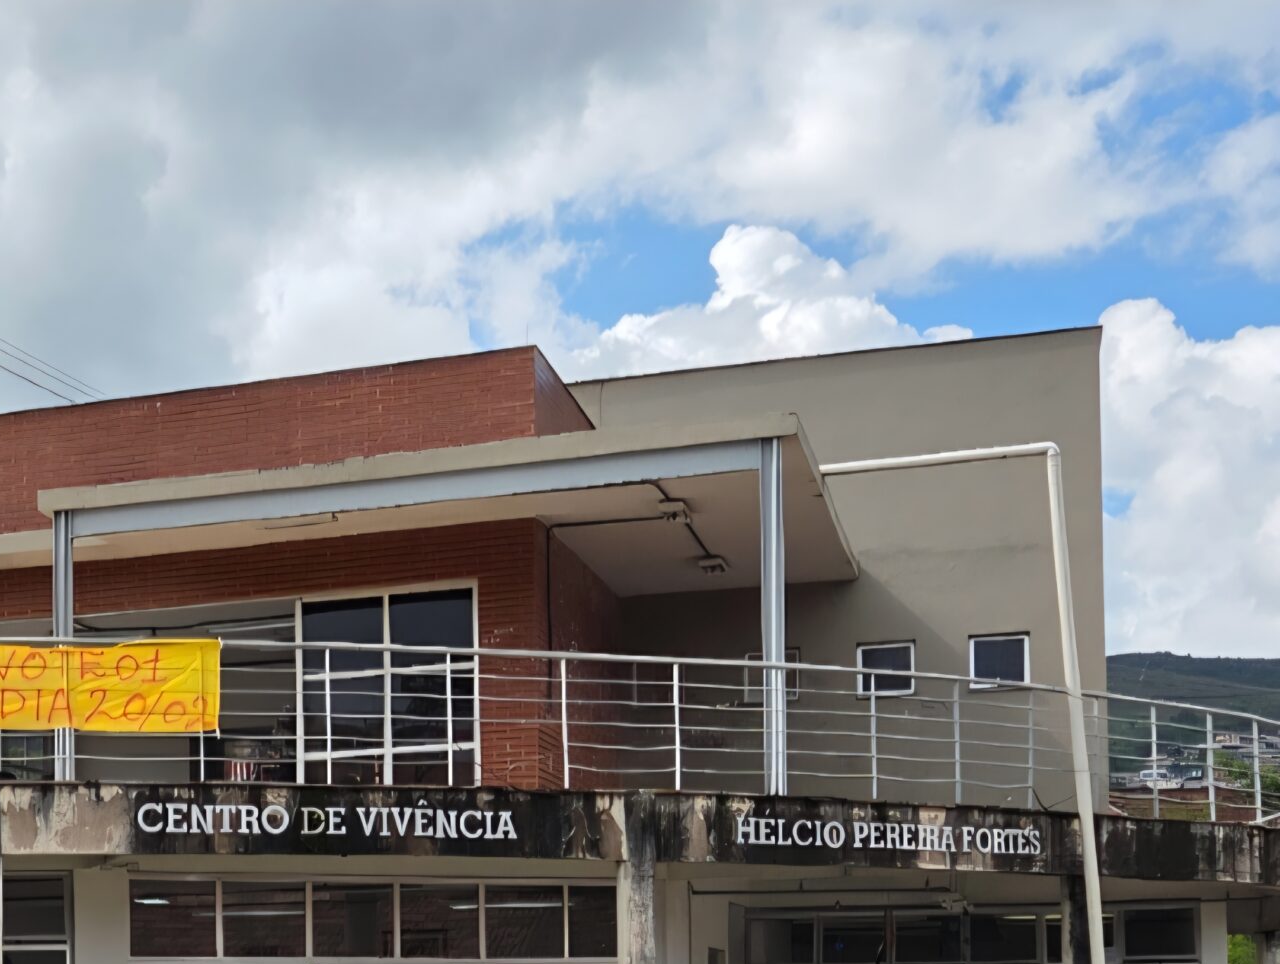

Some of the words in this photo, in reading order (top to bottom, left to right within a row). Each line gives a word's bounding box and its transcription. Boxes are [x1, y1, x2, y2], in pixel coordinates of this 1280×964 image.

[1, 688, 73, 725] DIA
[137, 802, 290, 835] CENTRO
[301, 806, 347, 835] DE
[356, 800, 518, 840] VIVÊNCIA
[853, 821, 957, 852] PEREIRA
[962, 824, 1041, 855] FORTES
